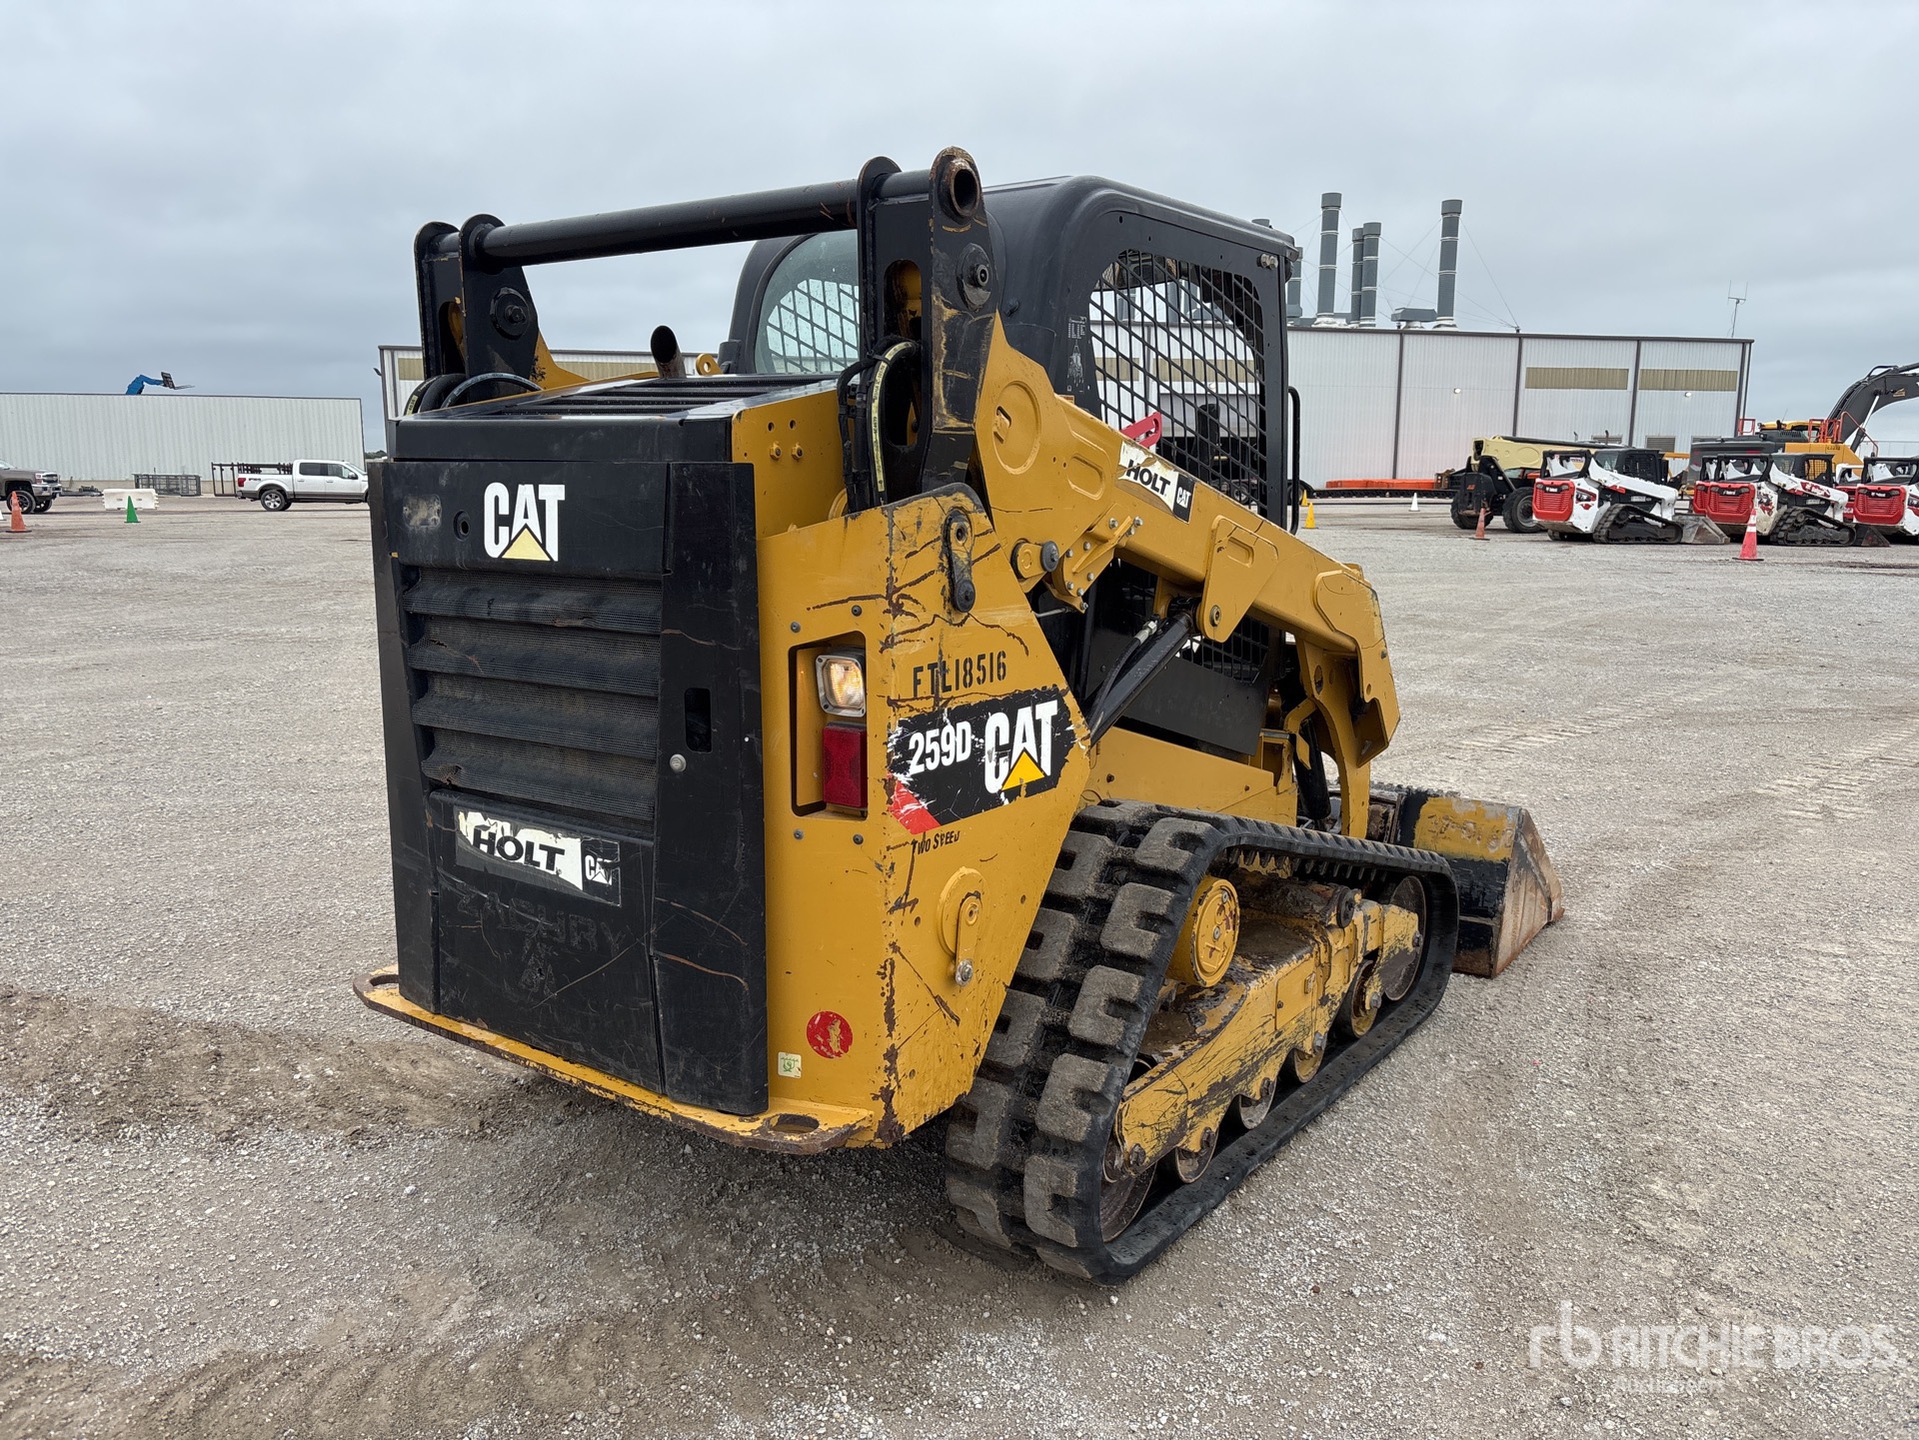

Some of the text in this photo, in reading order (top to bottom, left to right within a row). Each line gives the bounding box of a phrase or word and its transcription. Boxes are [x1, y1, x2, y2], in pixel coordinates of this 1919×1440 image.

[1126, 459, 1191, 508] HOLT CAT
[483, 481, 565, 562] CAT
[908, 700, 1058, 794] 259D CAT
[473, 827, 565, 872] HOLT
